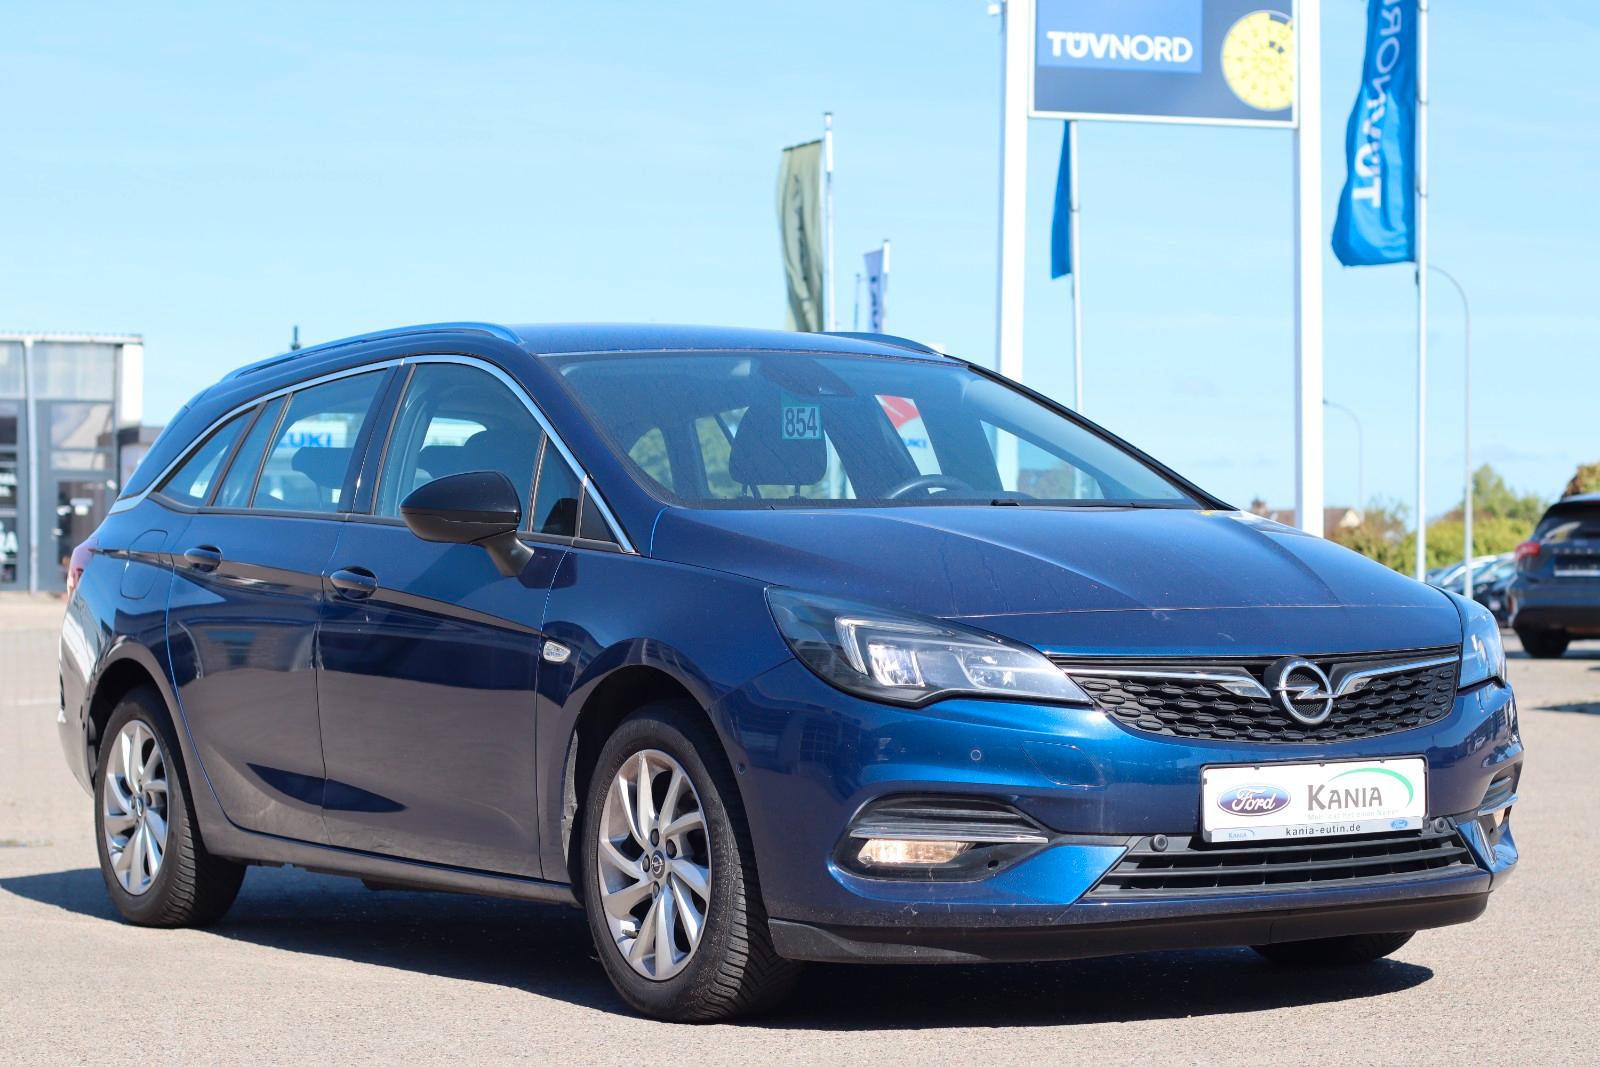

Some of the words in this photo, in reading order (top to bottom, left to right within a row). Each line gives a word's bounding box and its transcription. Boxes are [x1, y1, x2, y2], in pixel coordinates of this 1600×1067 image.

[1046, 30, 1194, 64] TÜVNORD
[784, 407, 818, 437] 854
[1231, 789, 1277, 811] Ford
[1307, 783, 1383, 811] KANIA
[1285, 823, 1361, 836] kania-eutin.de
